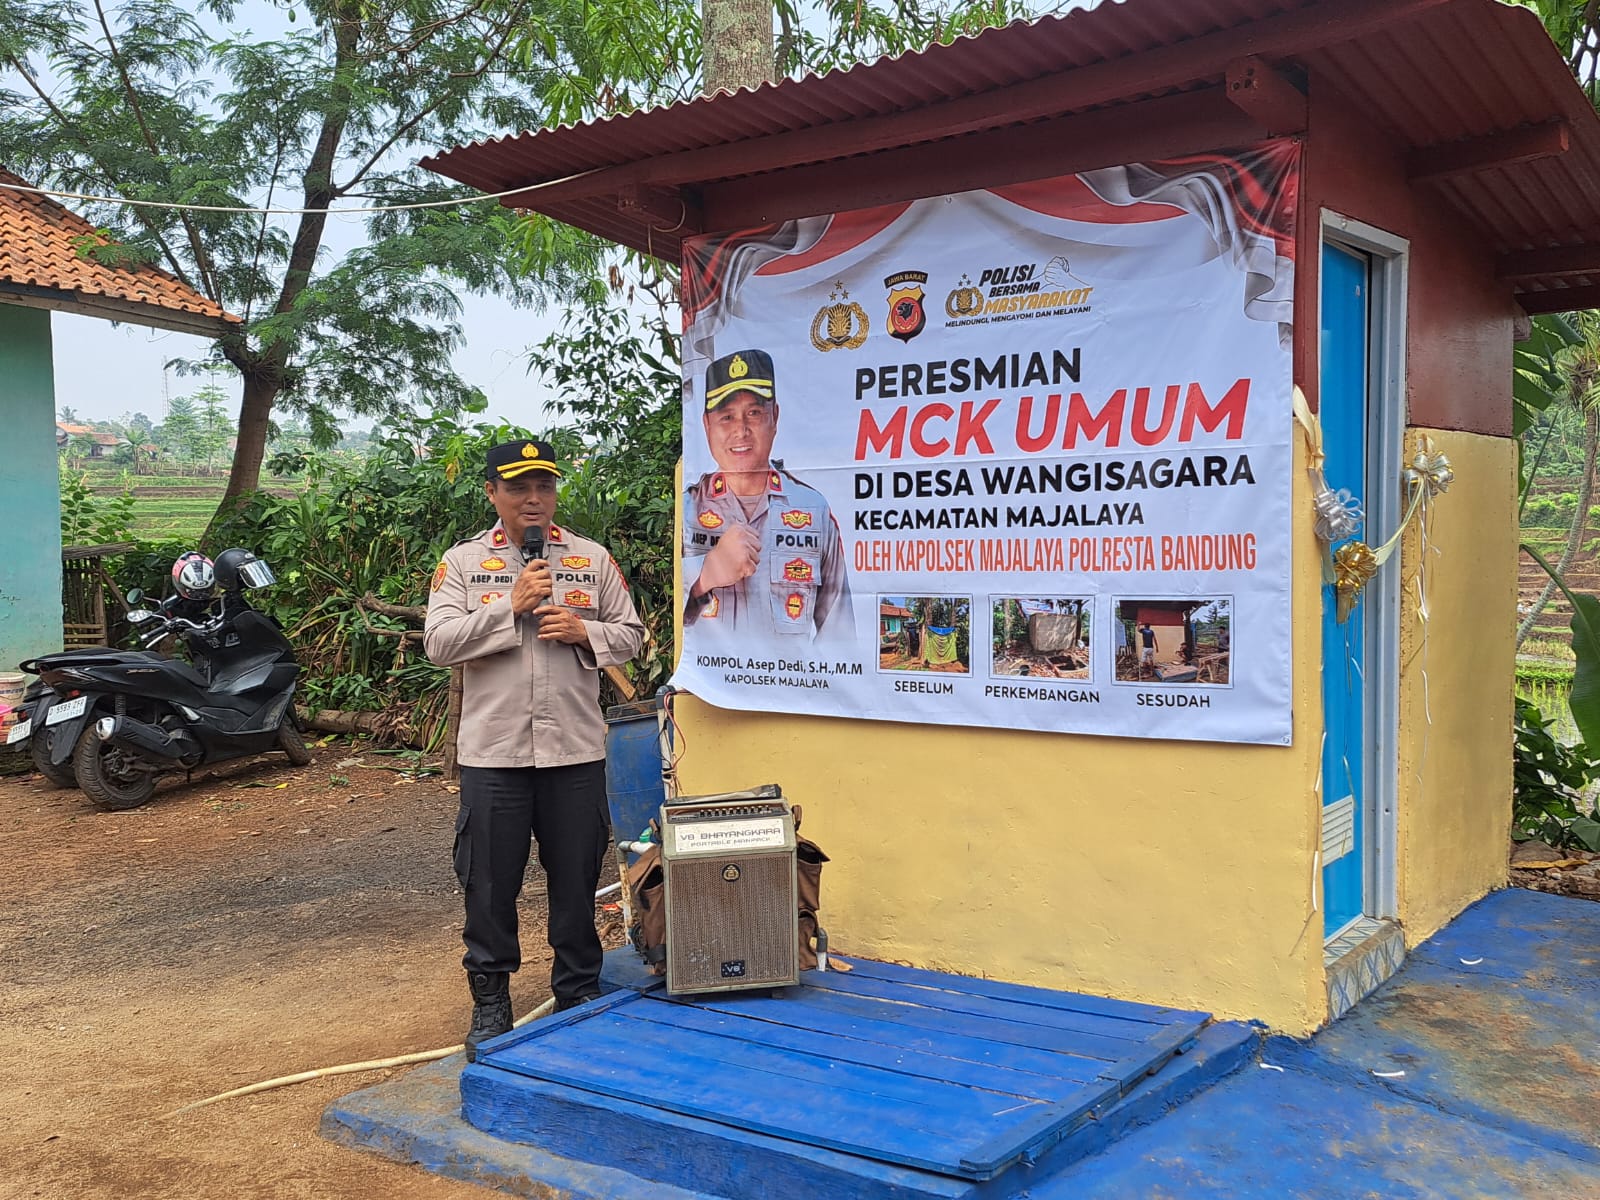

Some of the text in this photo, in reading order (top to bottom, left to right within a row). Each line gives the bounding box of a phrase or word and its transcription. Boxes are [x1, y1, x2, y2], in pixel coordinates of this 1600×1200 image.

[888, 275, 904, 285] JAWA
[979, 264, 1036, 286] POLISI
[989, 282, 1040, 298] BERSAMA
[983, 287, 1093, 315] MASYARAKAT
[991, 314, 1034, 323] MENGAYOMI
[1053, 306, 1091, 316] MELAYANI
[856, 348, 1081, 400] PERESMIAN
[854, 378, 1251, 460] MCK UMUM
[854, 454, 1256, 500] DI DESA WANGISAGARA
[854, 503, 1145, 530] KECAMATAN MAJALAYA
[776, 535, 817, 547] POLRI
[854, 533, 1256, 571] OLEH KAPOLSEK MAJALAYA POLRESTA BANDUNG
[495, 576, 512, 584] DEDI
[556, 573, 595, 583] POLRI
[697, 655, 743, 670] KOMPOL
[746, 658, 775, 673] Asep
[778, 660, 806, 673] Dedi,
[724, 674, 829, 689] KAPOLSEK MAJALAYA
[894, 680, 953, 694] SEBELUM
[985, 685, 1100, 703] PERKEMBANGAN
[1137, 693, 1210, 708] SESUDAH
[701, 828, 780, 840] BHAYANGKARA
